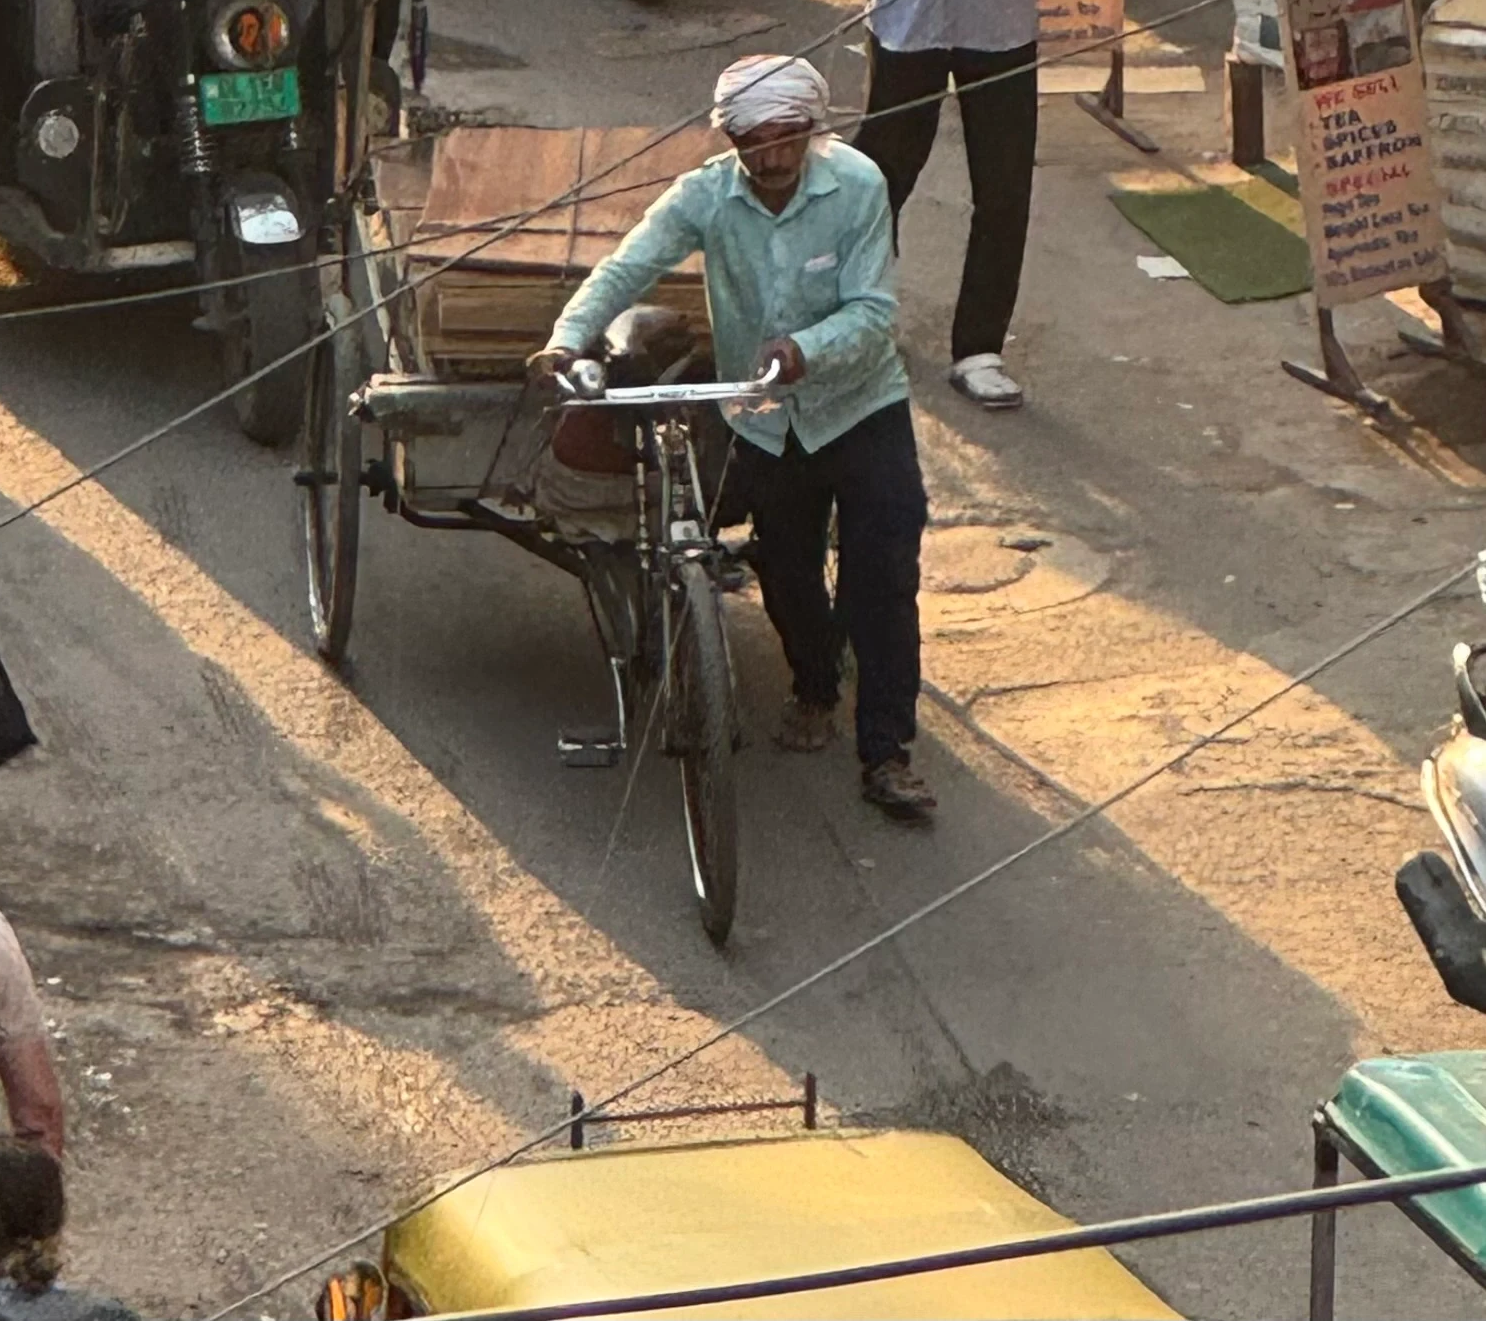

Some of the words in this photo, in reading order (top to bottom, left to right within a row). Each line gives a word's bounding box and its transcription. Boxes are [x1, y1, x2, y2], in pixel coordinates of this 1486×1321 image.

[1319, 109, 1362, 131] TEA
[1322, 119, 1397, 151] SPICES
[1325, 133, 1422, 170] SAFFRON
